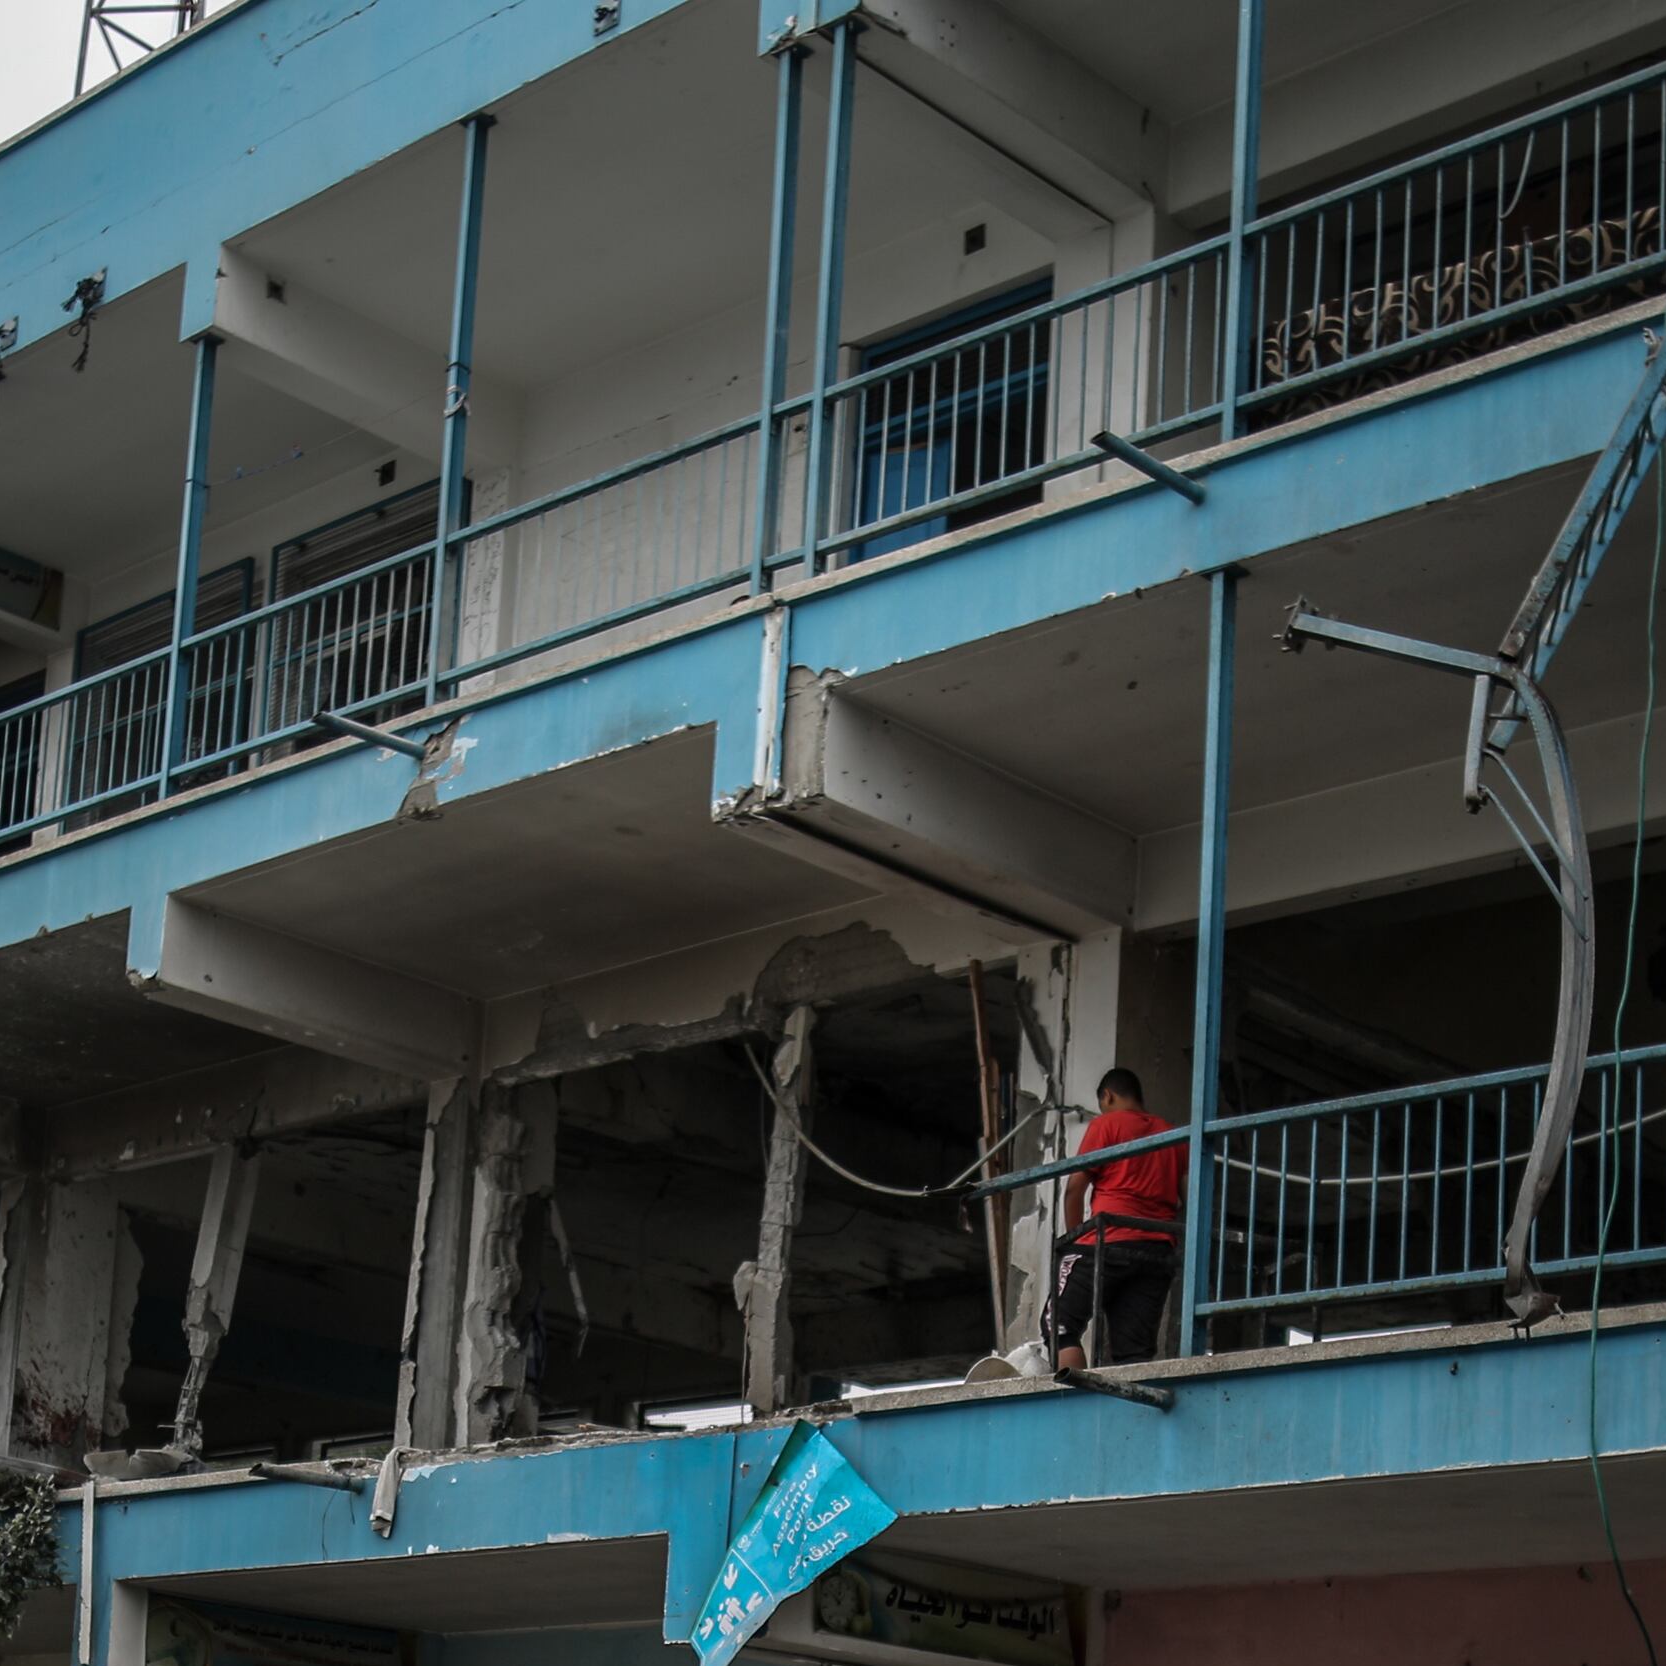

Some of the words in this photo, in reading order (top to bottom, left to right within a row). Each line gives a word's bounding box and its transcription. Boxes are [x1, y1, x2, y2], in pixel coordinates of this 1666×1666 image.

[771, 1462, 819, 1558] Assembly
[772, 1481, 798, 1519] Fire
[786, 1492, 816, 1546] Point
[805, 1494, 853, 1534] نقطة
[808, 1530, 849, 1563] حريق
[954, 1600, 993, 1630] هو
[996, 1602, 1055, 1642] الوقت
